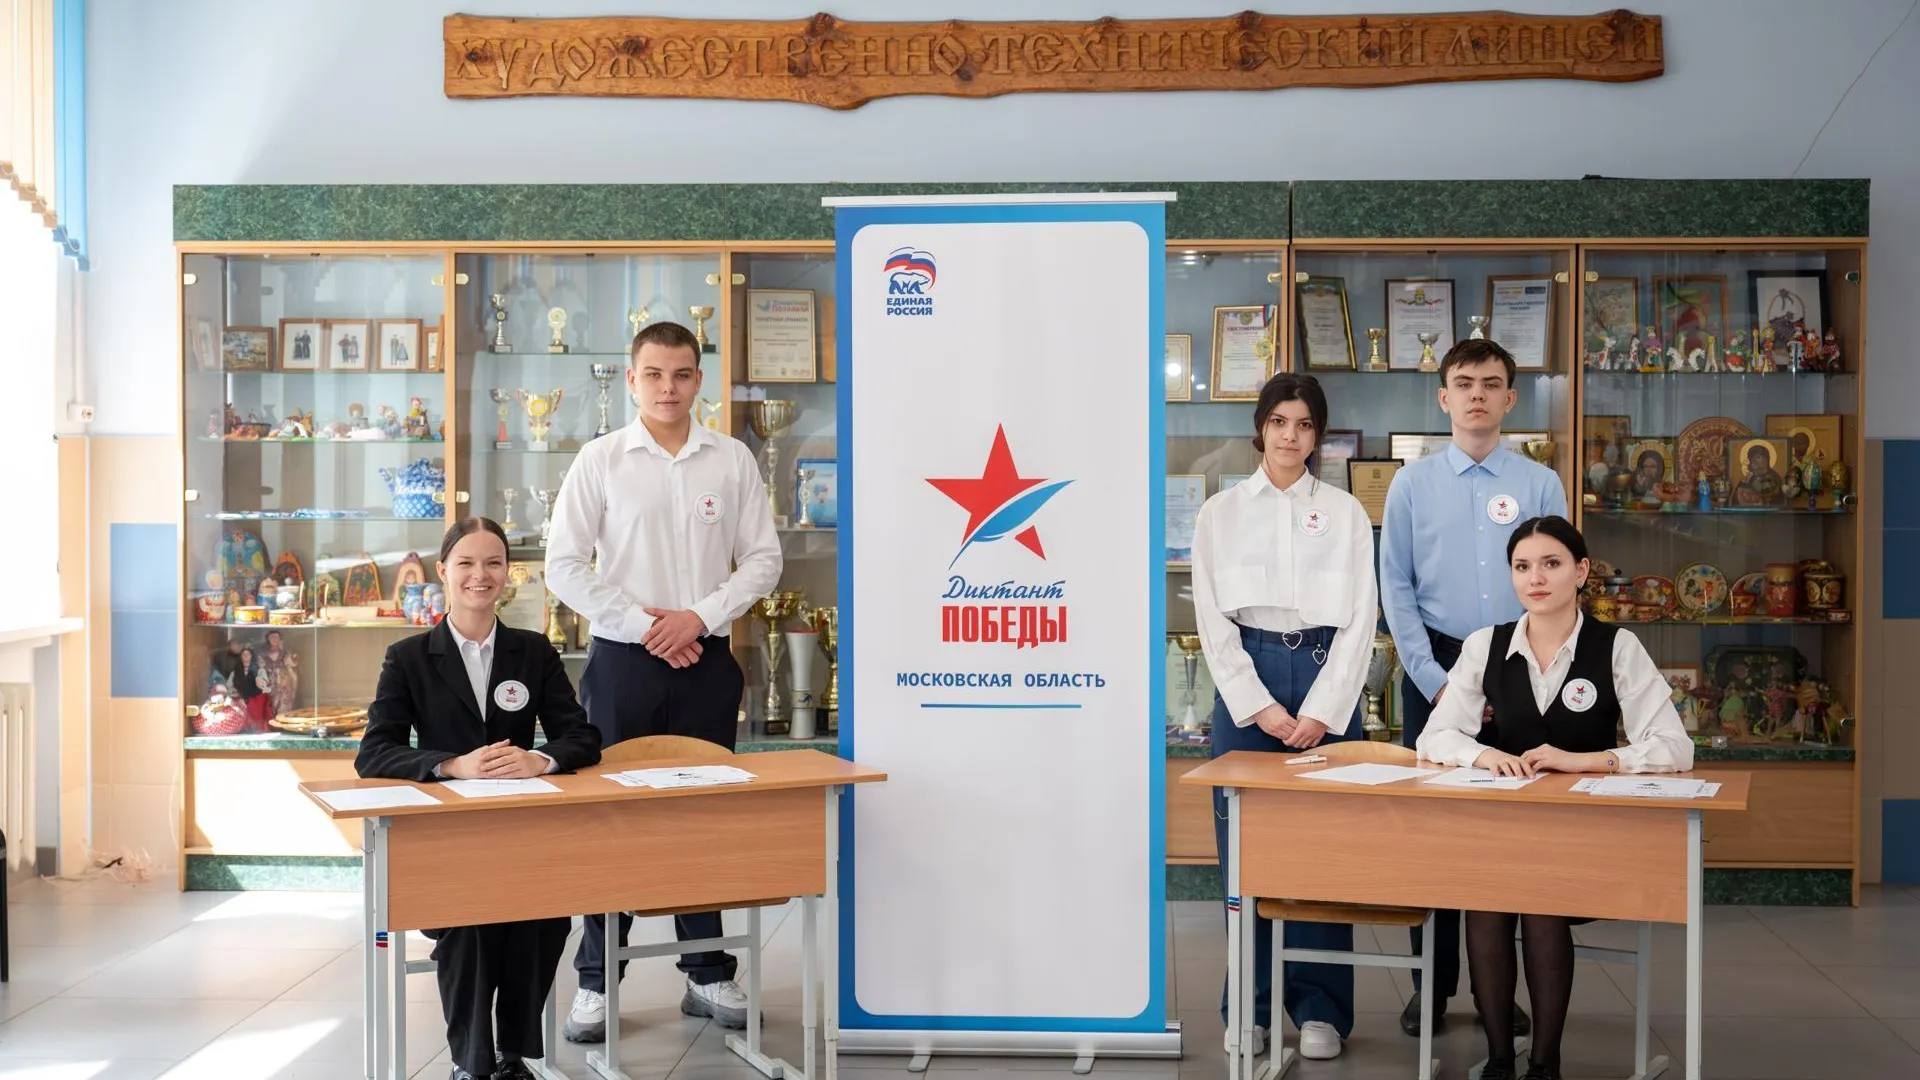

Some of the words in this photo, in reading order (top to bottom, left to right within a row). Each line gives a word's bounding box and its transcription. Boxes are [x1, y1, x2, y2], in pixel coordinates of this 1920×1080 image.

[886, 297, 933, 307] ЕДИНАЯ
[886, 307, 933, 316] РОССИЯ
[941, 575, 1067, 600] Диктант
[942, 605, 1067, 650] ПОБЕДЫ
[896, 672, 1012, 688] МОСКОВСКАЯ
[1024, 673, 1106, 688] ОБЛАСТЬ
